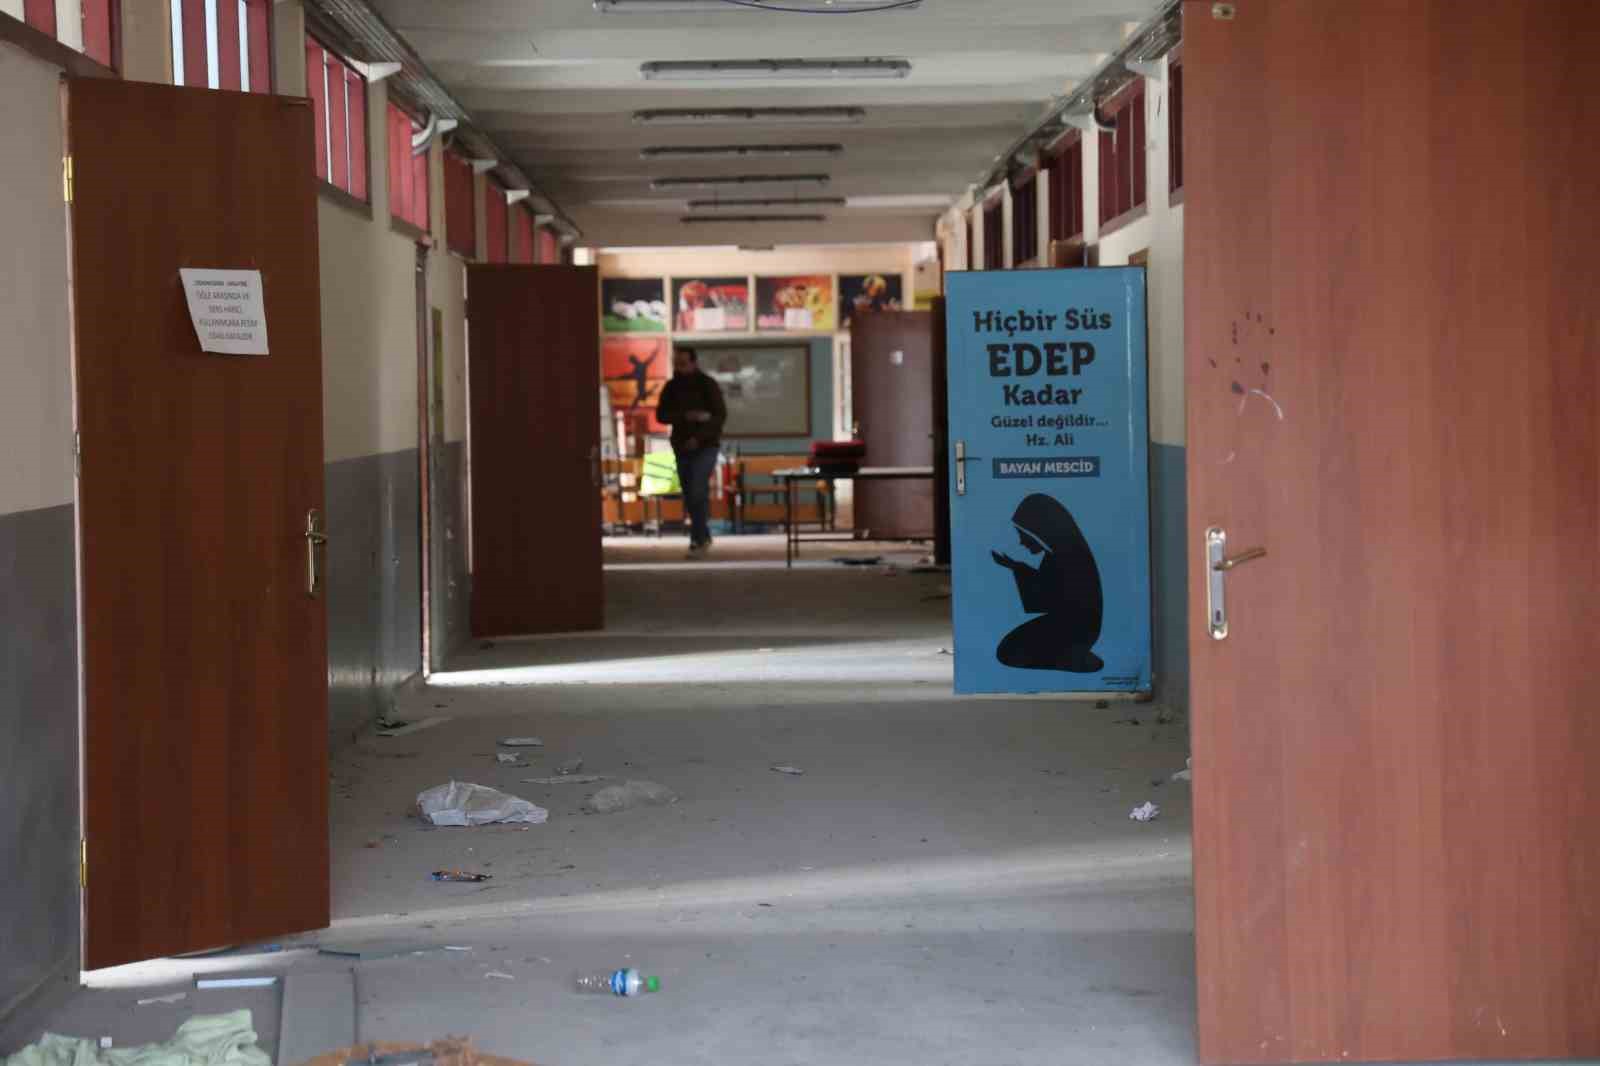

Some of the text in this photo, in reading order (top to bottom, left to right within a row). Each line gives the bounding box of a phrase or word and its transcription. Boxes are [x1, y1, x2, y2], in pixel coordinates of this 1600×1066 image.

[973, 306, 1112, 336] Hiçbir Süs
[986, 342, 1096, 377] EDEP
[1002, 384, 1083, 406] Kadar
[991, 414, 1109, 430] Güzel değildir...
[1025, 433, 1074, 446] Hz. Ali
[999, 461, 1094, 474] BAYAN MESCİD
